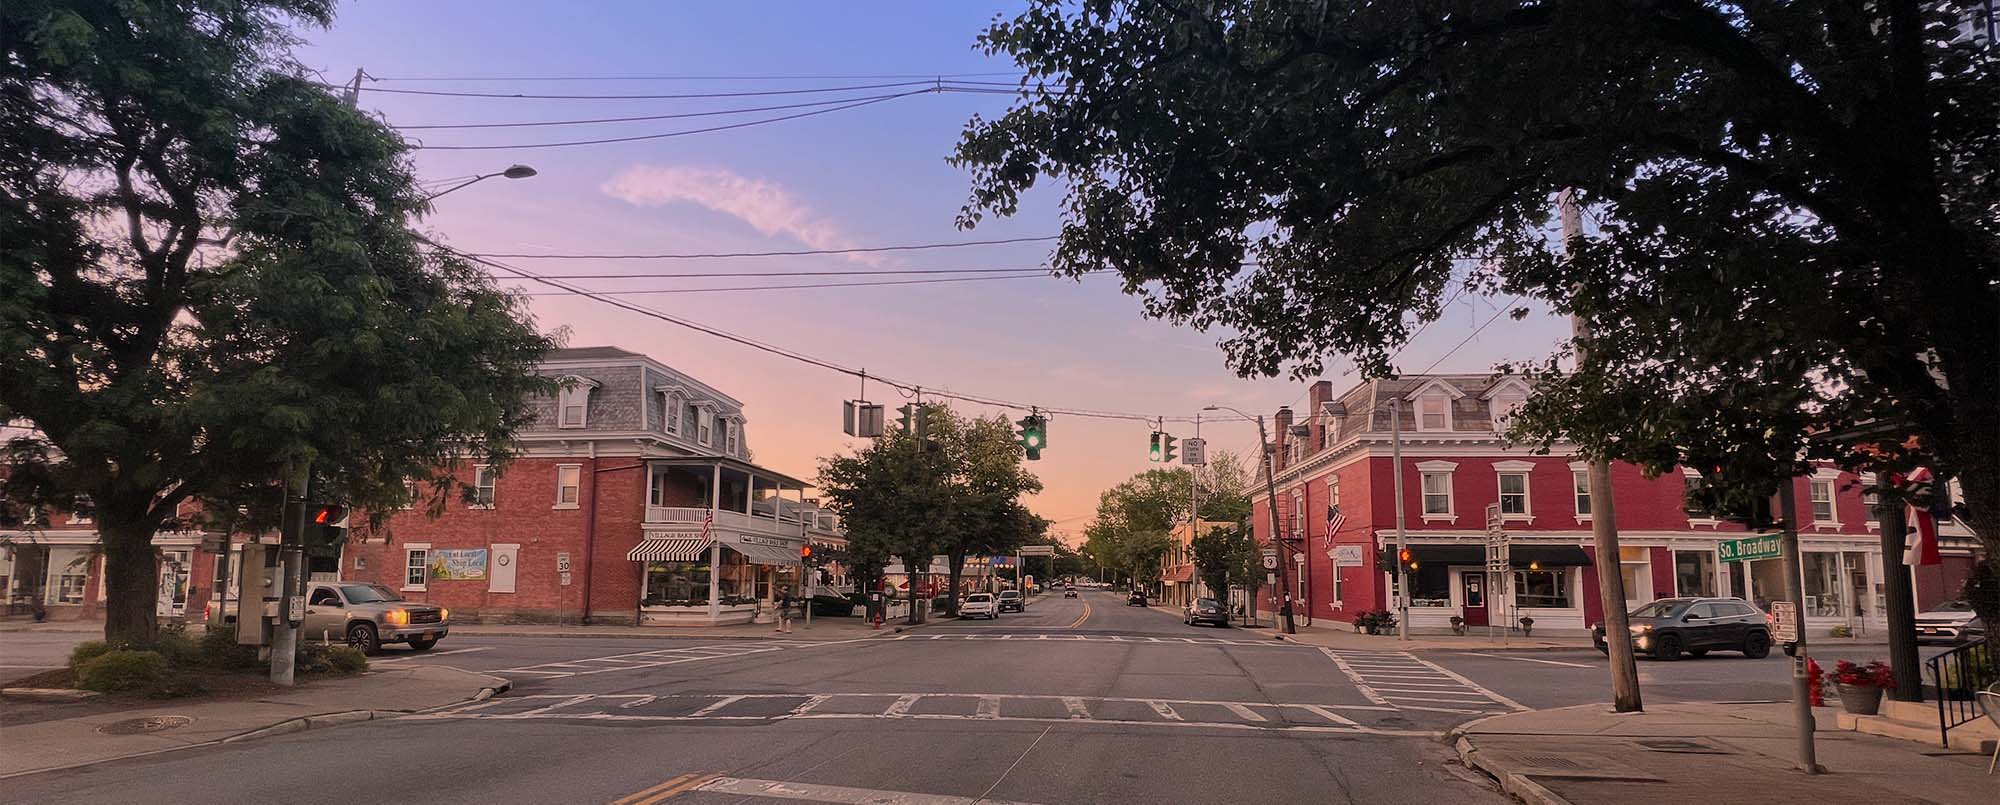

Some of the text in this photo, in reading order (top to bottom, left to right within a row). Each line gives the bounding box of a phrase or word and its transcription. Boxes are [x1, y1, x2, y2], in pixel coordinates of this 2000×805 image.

[1720, 538, 1781, 558] So. Broadway
[559, 562, 570, 570] 30
[1267, 558, 1273, 566] 9
